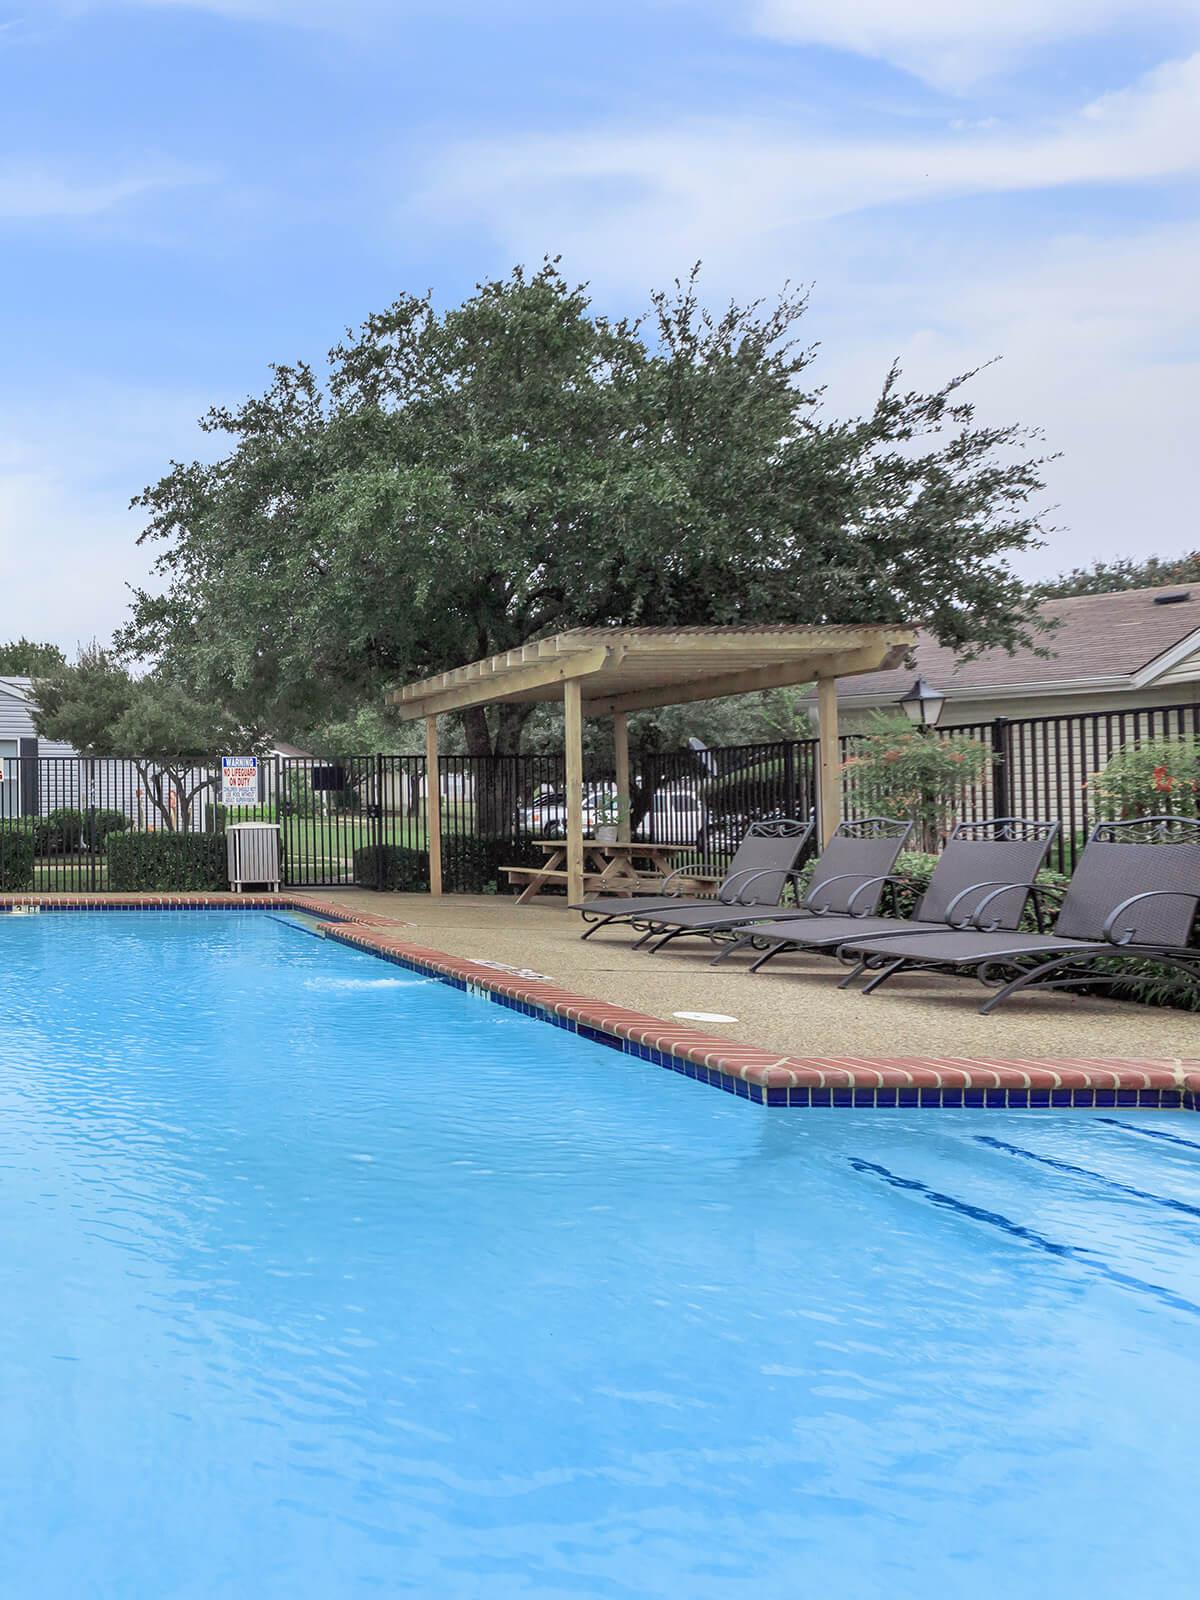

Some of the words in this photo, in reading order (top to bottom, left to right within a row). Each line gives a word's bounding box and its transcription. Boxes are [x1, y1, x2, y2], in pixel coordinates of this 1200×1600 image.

[226, 758, 253, 767] WARNING
[223, 767, 231, 777] NO
[232, 767, 256, 777] LIFEGUARD
[229, 777, 236, 786] ON
[237, 777, 250, 786] DUTY
